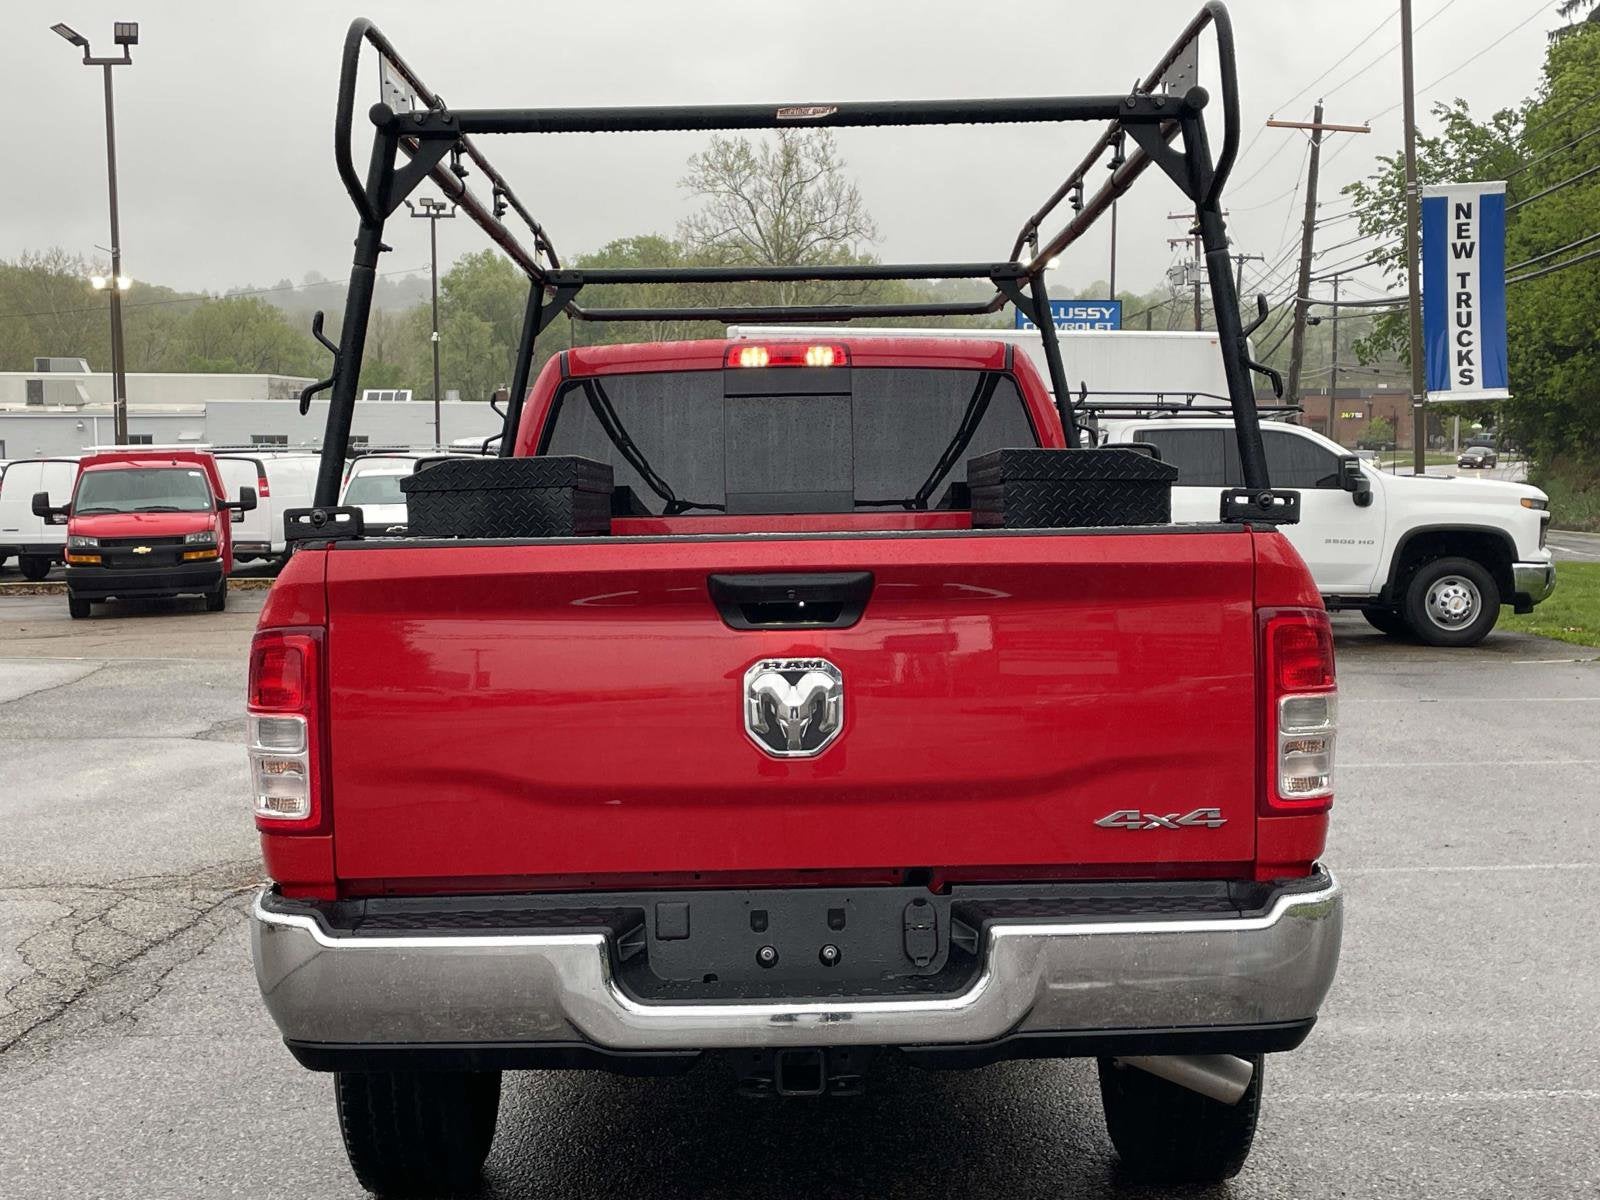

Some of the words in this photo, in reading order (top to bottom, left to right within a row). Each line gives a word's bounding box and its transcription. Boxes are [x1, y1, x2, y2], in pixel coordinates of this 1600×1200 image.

[1452, 202, 1475, 259] NEW
[1456, 272, 1475, 386] TRUCKS
[763, 661, 823, 670] RAM
[1093, 808, 1228, 829] 4x4
